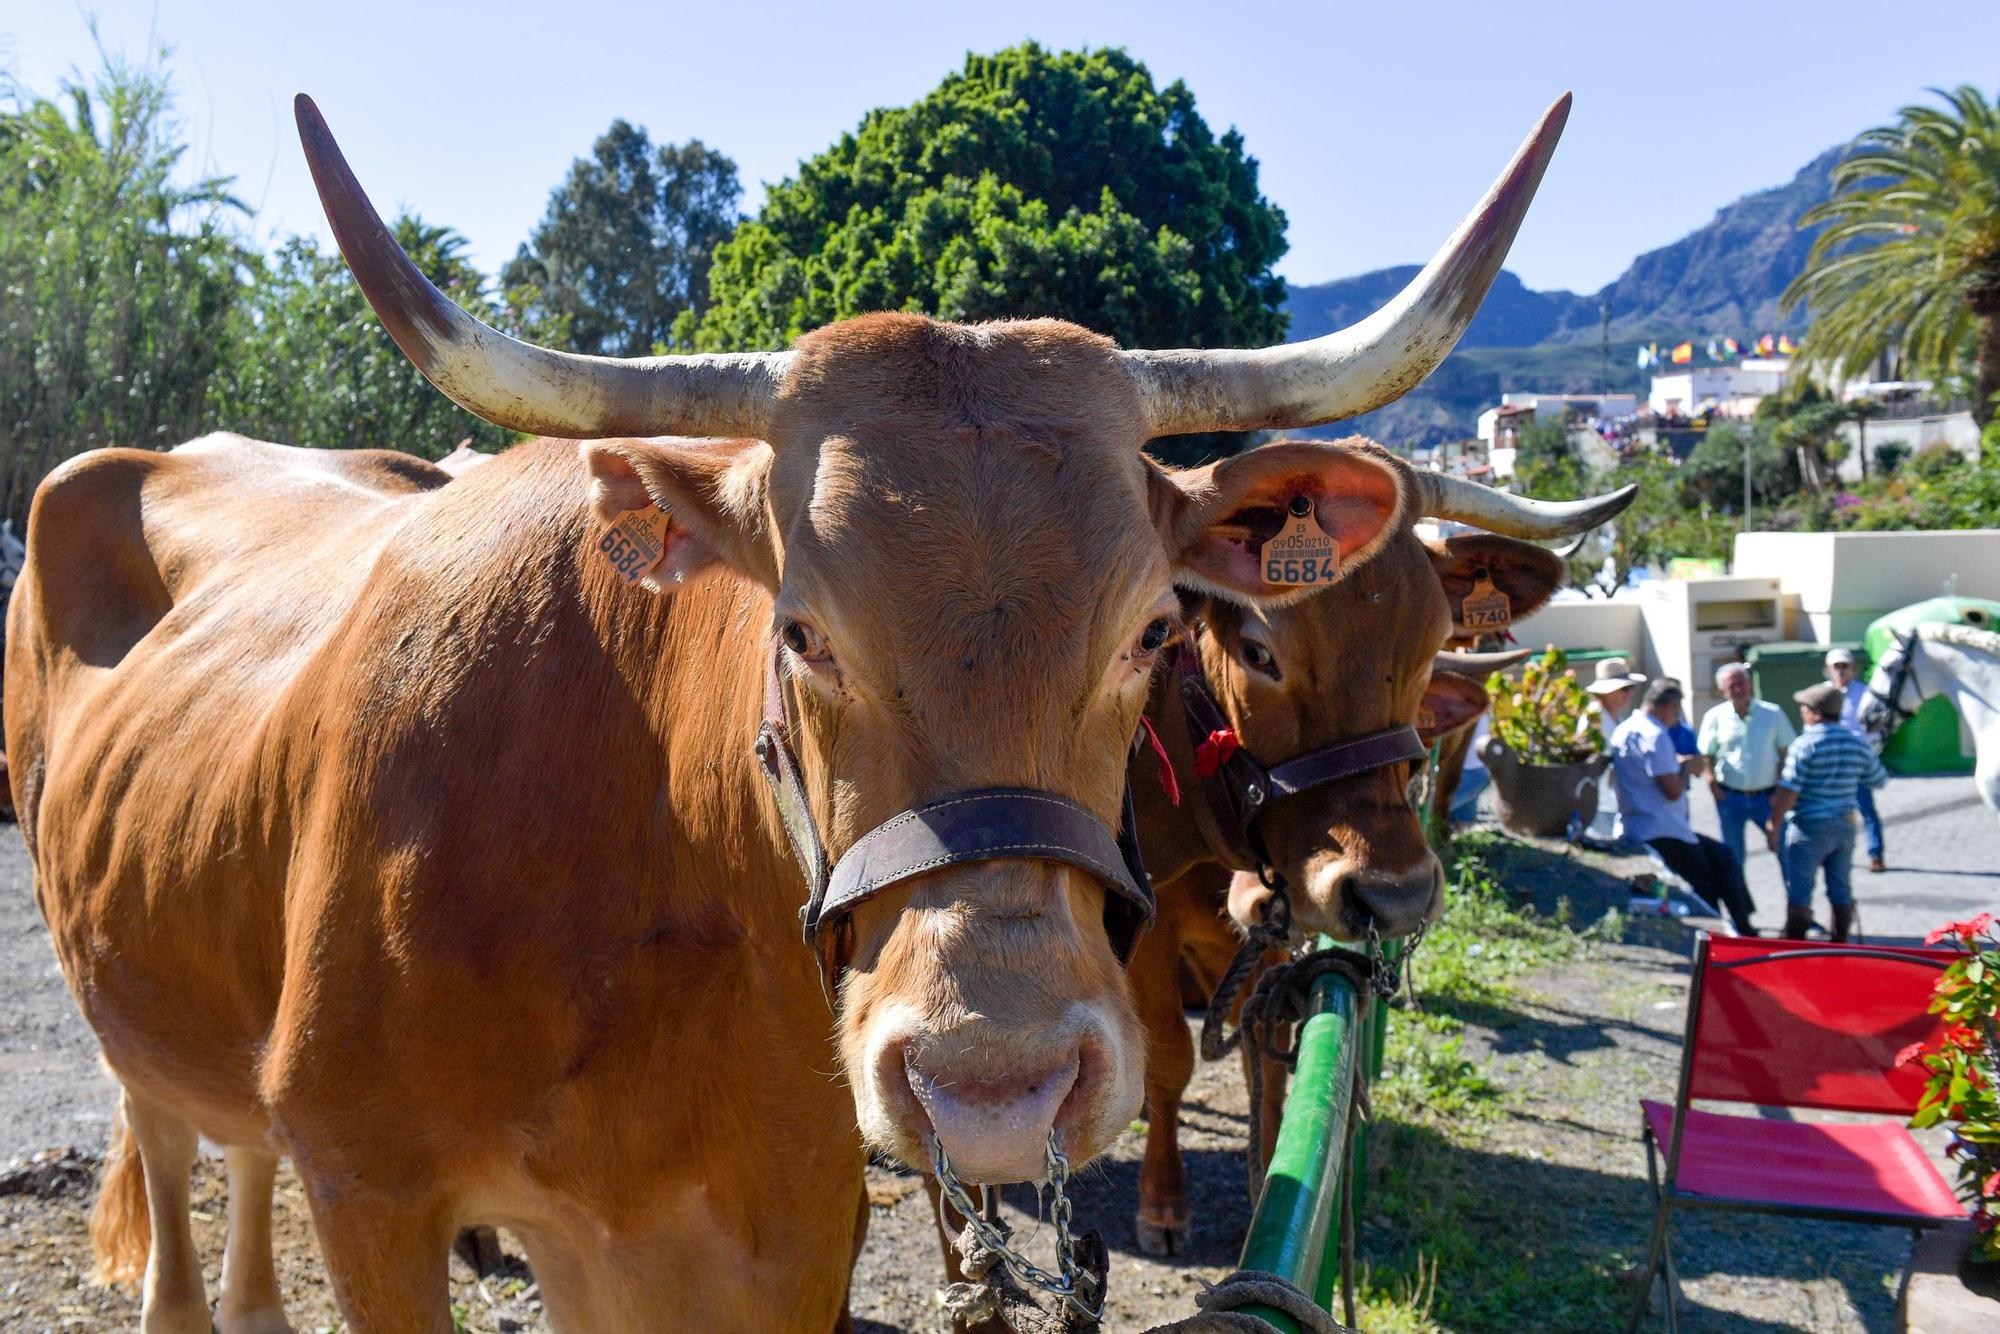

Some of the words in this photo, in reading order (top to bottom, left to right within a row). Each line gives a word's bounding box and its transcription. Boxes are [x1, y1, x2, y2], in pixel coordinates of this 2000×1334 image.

[1296, 523, 1307, 533] ES
[601, 527, 648, 583] 6684
[1267, 556, 1335, 583] 6684
[1466, 609, 1508, 626] 1740
